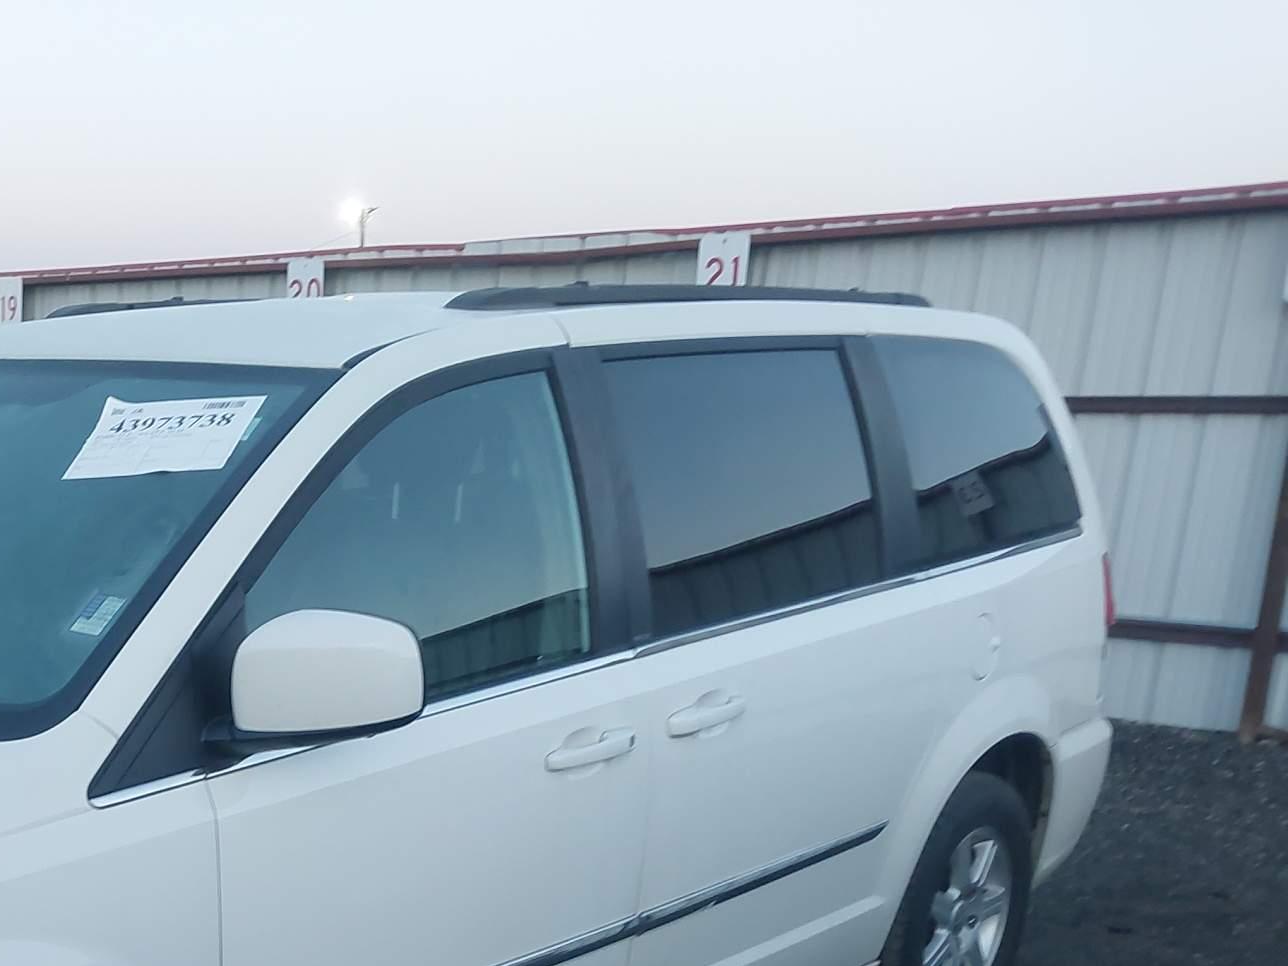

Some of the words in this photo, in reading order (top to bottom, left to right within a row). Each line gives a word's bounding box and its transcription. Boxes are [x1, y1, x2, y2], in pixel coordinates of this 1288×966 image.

[705, 256, 740, 287] 21
[0, 295, 18, 322] 19
[109, 412, 236, 433] 43973738
